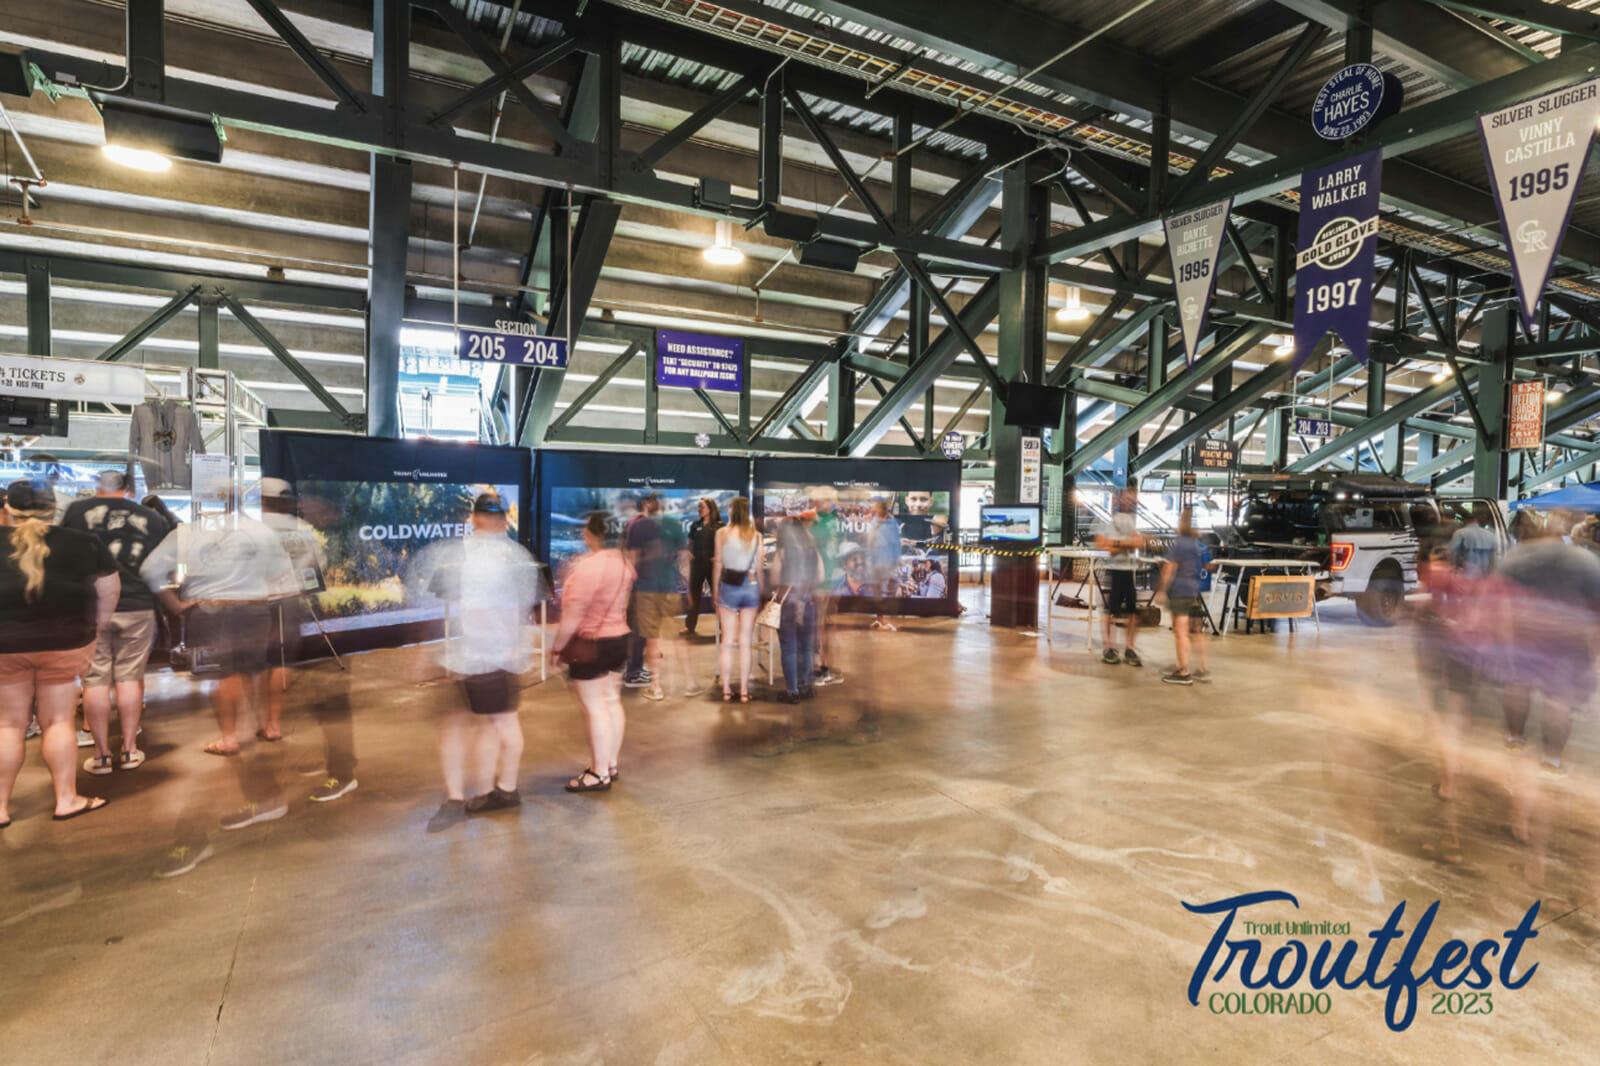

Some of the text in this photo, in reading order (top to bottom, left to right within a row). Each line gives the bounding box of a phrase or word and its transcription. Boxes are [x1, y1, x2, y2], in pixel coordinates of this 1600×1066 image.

[1315, 89, 1330, 112] FIRST
[1329, 68, 1352, 88] STEAL
[1355, 67, 1367, 75] OF
[1330, 82, 1363, 103] CHARLIE
[1324, 91, 1370, 124] HAYES
[1491, 84, 1597, 129] SILVER SLUGGER
[1519, 116, 1564, 142] VINNY
[1505, 132, 1576, 164] CASTILLA
[1318, 164, 1362, 191] LARRY
[1509, 162, 1569, 201] 1995
[1312, 181, 1367, 210] WALKER
[1170, 205, 1224, 230] SILVER SLUGGER
[1183, 225, 1208, 242] DANTE
[1302, 220, 1375, 263] GOLD GLOVE
[1328, 247, 1351, 263] AWARD
[1179, 258, 1209, 283] 1995
[1306, 278, 1362, 314] 1997
[495, 320, 537, 336] SECTION
[468, 334, 559, 366] 205 204
[667, 342, 734, 359] NEED ASSISTANCE?
[9, 367, 66, 383] TICKETS
[664, 366, 676, 375] FOR
[677, 367, 690, 376] ANY
[1298, 420, 1329, 435] 204 203
[359, 522, 475, 541] COLDWATER
[1265, 591, 1303, 603] ORVIS
